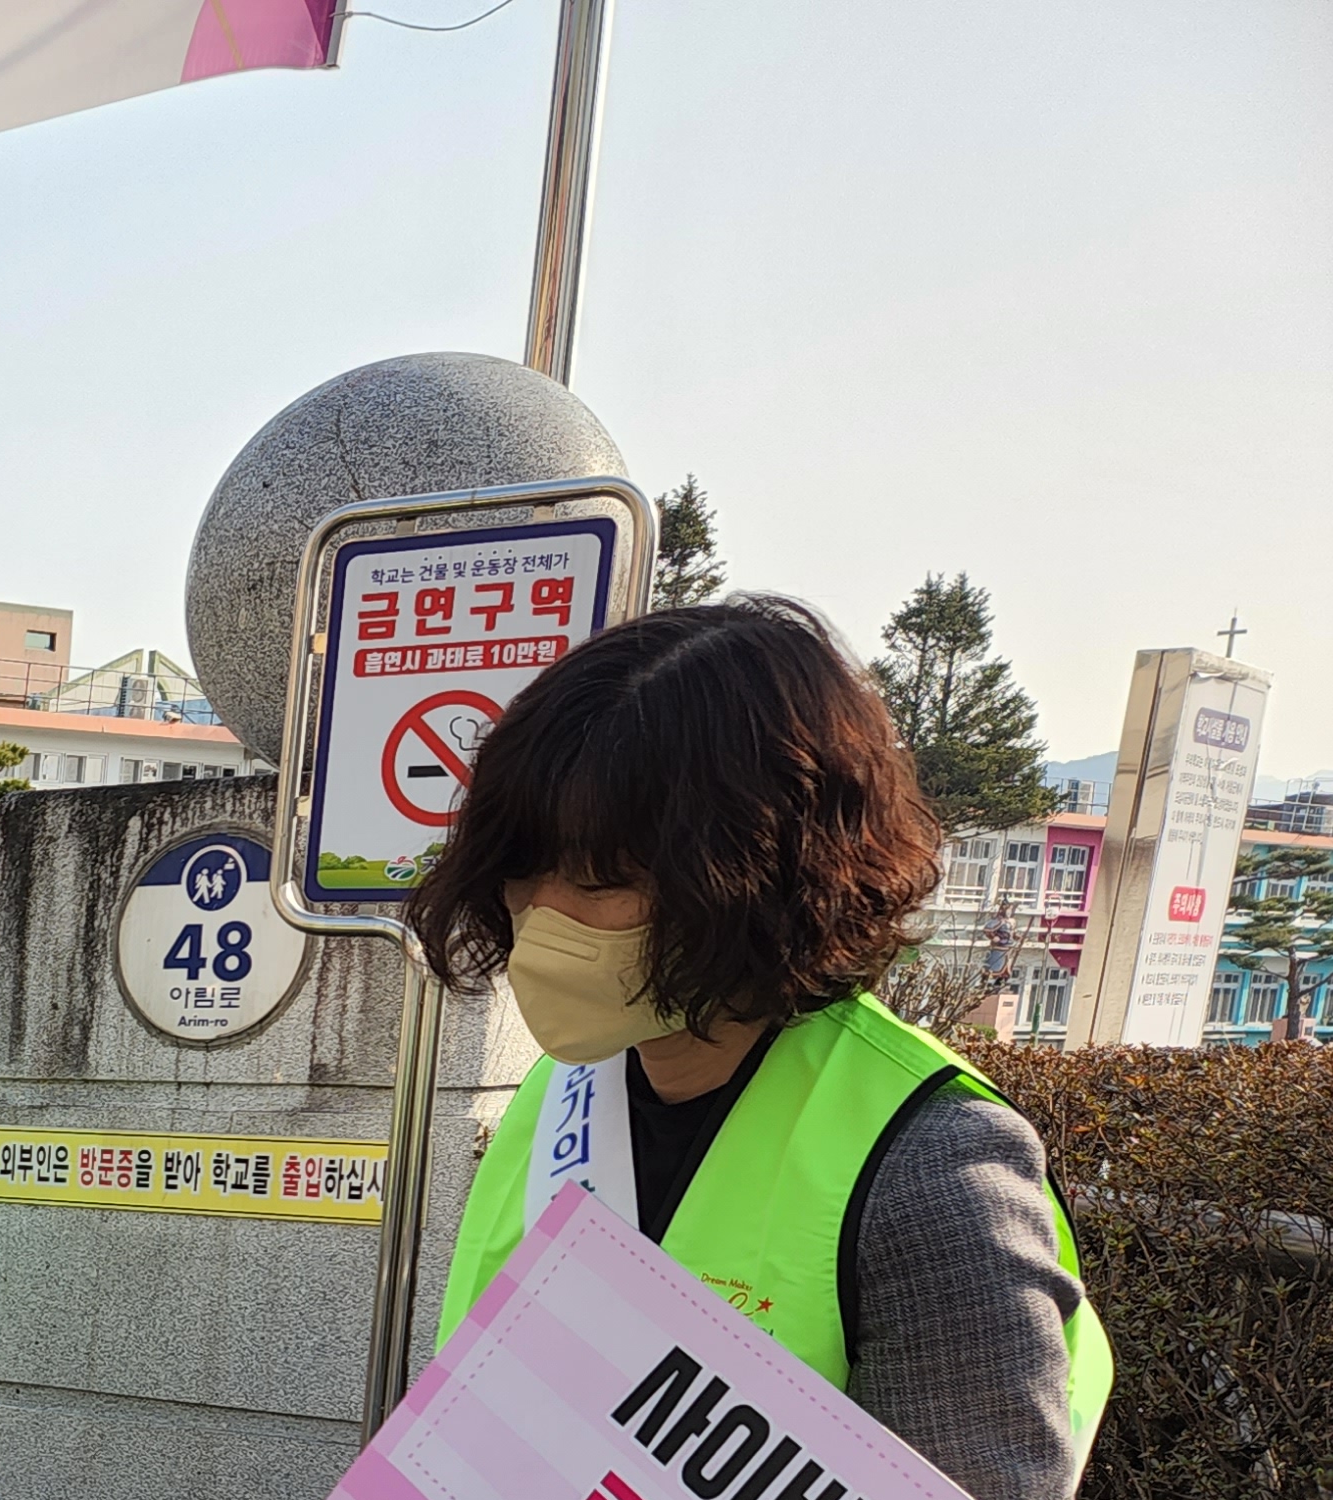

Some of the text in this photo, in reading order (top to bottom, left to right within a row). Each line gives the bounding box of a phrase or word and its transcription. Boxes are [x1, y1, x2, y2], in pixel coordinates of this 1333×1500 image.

[371, 552, 571, 586] 학교는 건물 및 운동장 전체가
[357, 575, 575, 642] 금연구역
[364, 638, 558, 674] 흡연시 과태료 10만원
[162, 920, 254, 983] 48
[169, 985, 243, 1011] 아림로
[177, 1015, 229, 1029] Arim-ro
[0, 1142, 71, 1185] 외부인은
[79, 1146, 153, 1191] 방문증을
[164, 1149, 202, 1193] 받아
[211, 1152, 271, 1196] 학교를
[700, 1272, 728, 1288] Dream
